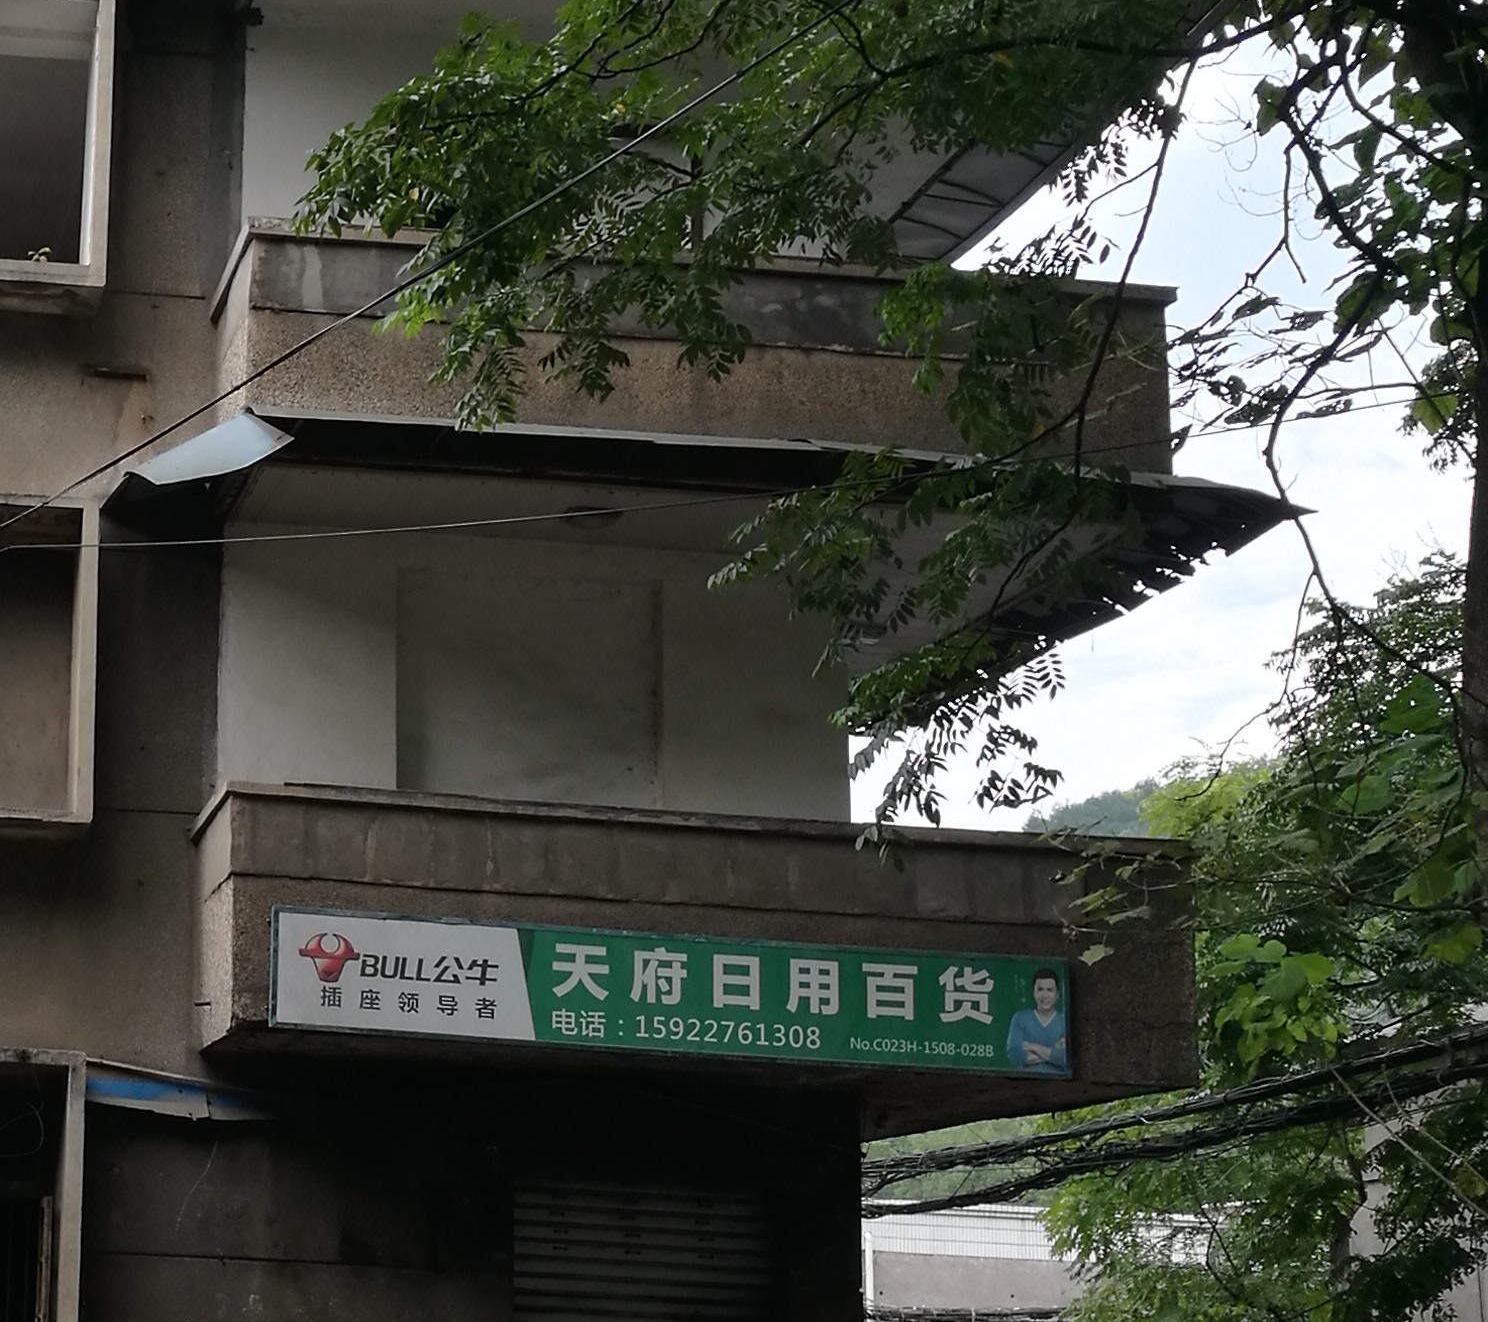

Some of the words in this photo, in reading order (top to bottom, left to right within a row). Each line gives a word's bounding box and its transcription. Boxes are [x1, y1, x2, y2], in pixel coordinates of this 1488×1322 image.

[551, 942, 996, 1025] 天府日用百货
[320, 986, 498, 1020] 插座领导者
[849, 1036, 995, 1058] No.C023H-1508-028B
